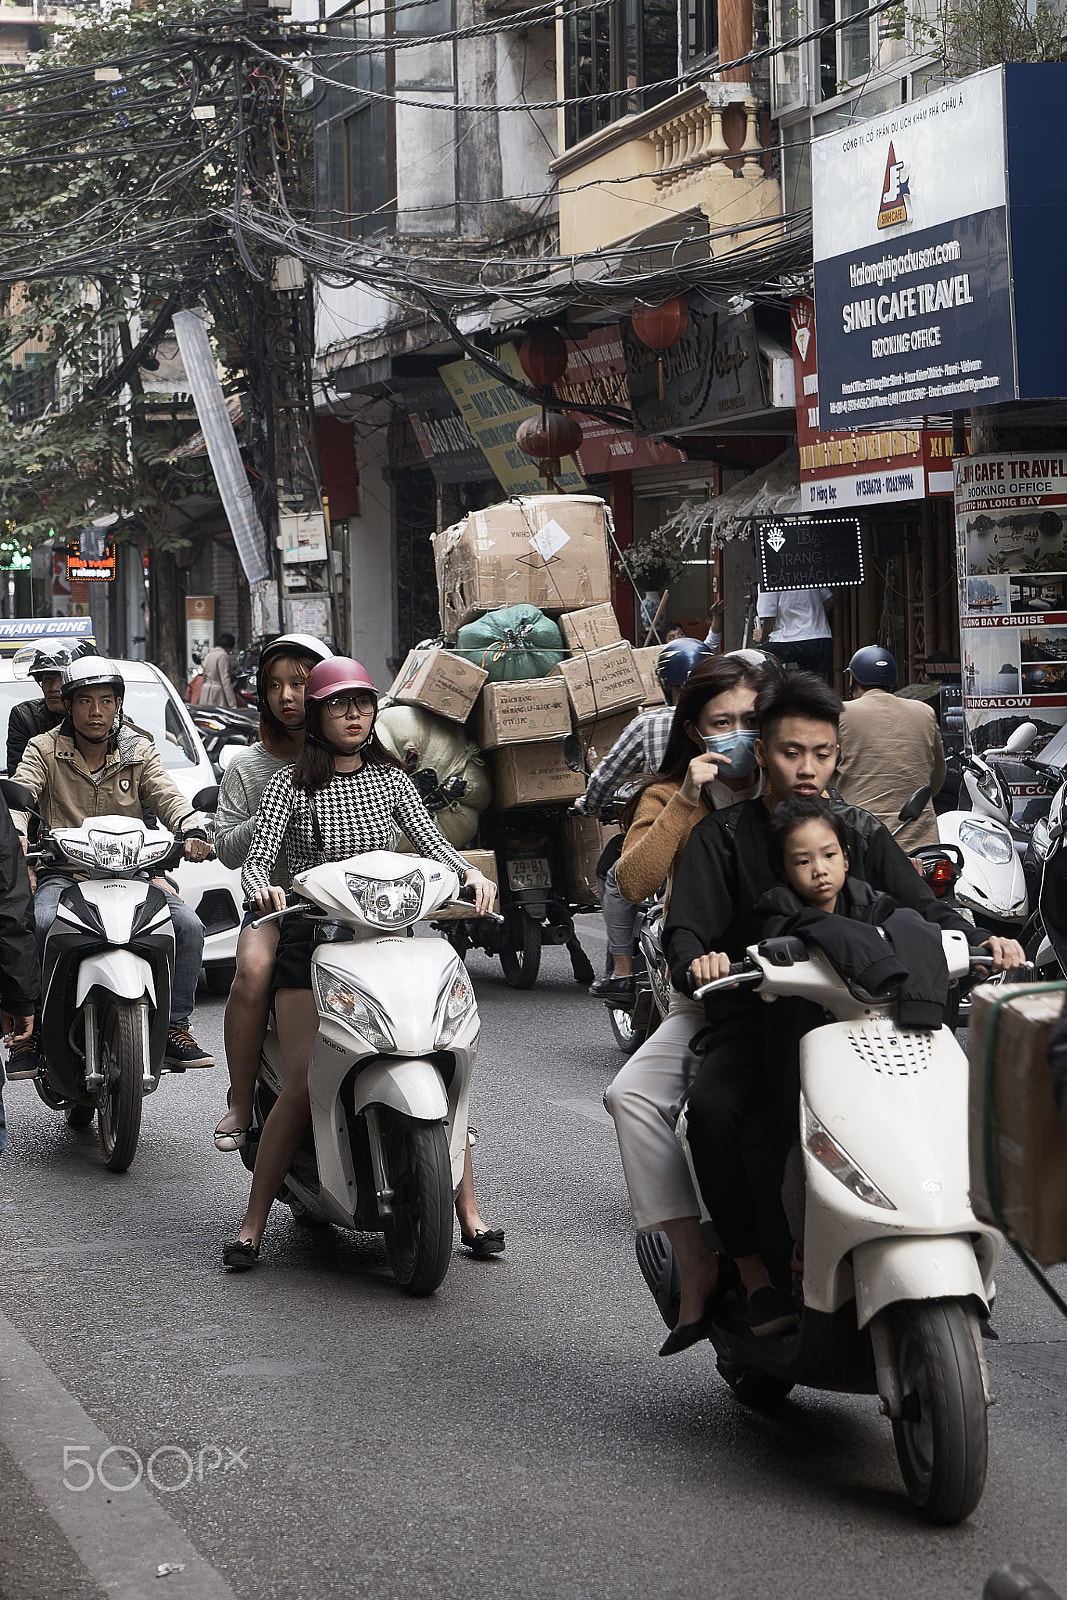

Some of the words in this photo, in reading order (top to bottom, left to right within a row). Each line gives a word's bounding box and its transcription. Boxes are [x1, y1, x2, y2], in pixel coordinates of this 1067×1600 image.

[842, 298, 877, 334] SINH
[877, 287, 917, 324] CAFE
[917, 273, 974, 314] TRAVEL
[871, 332, 910, 360] BOOKING
[910, 326, 942, 350] OFFICE
[929, 437, 943, 458] XI
[974, 461, 1005, 482] CAFE
[1008, 459, 1067, 479] TRAVEL
[968, 484, 1006, 498] BOOKING
[1009, 481, 1053, 494] OFFICE
[977, 500, 988, 510] HA
[989, 498, 1017, 508] LONG
[1019, 496, 1042, 506] BAY
[511, 530, 531, 539] CHINA
[779, 550, 823, 567] TRANG
[0, 622, 46, 637] THANH
[46, 621, 88, 633] CONG
[981, 616, 1000, 627] BAY
[1002, 614, 1045, 626] CRUISE
[967, 698, 1032, 708] BUNGALOW
[321, 1036, 348, 1056] HONDA
